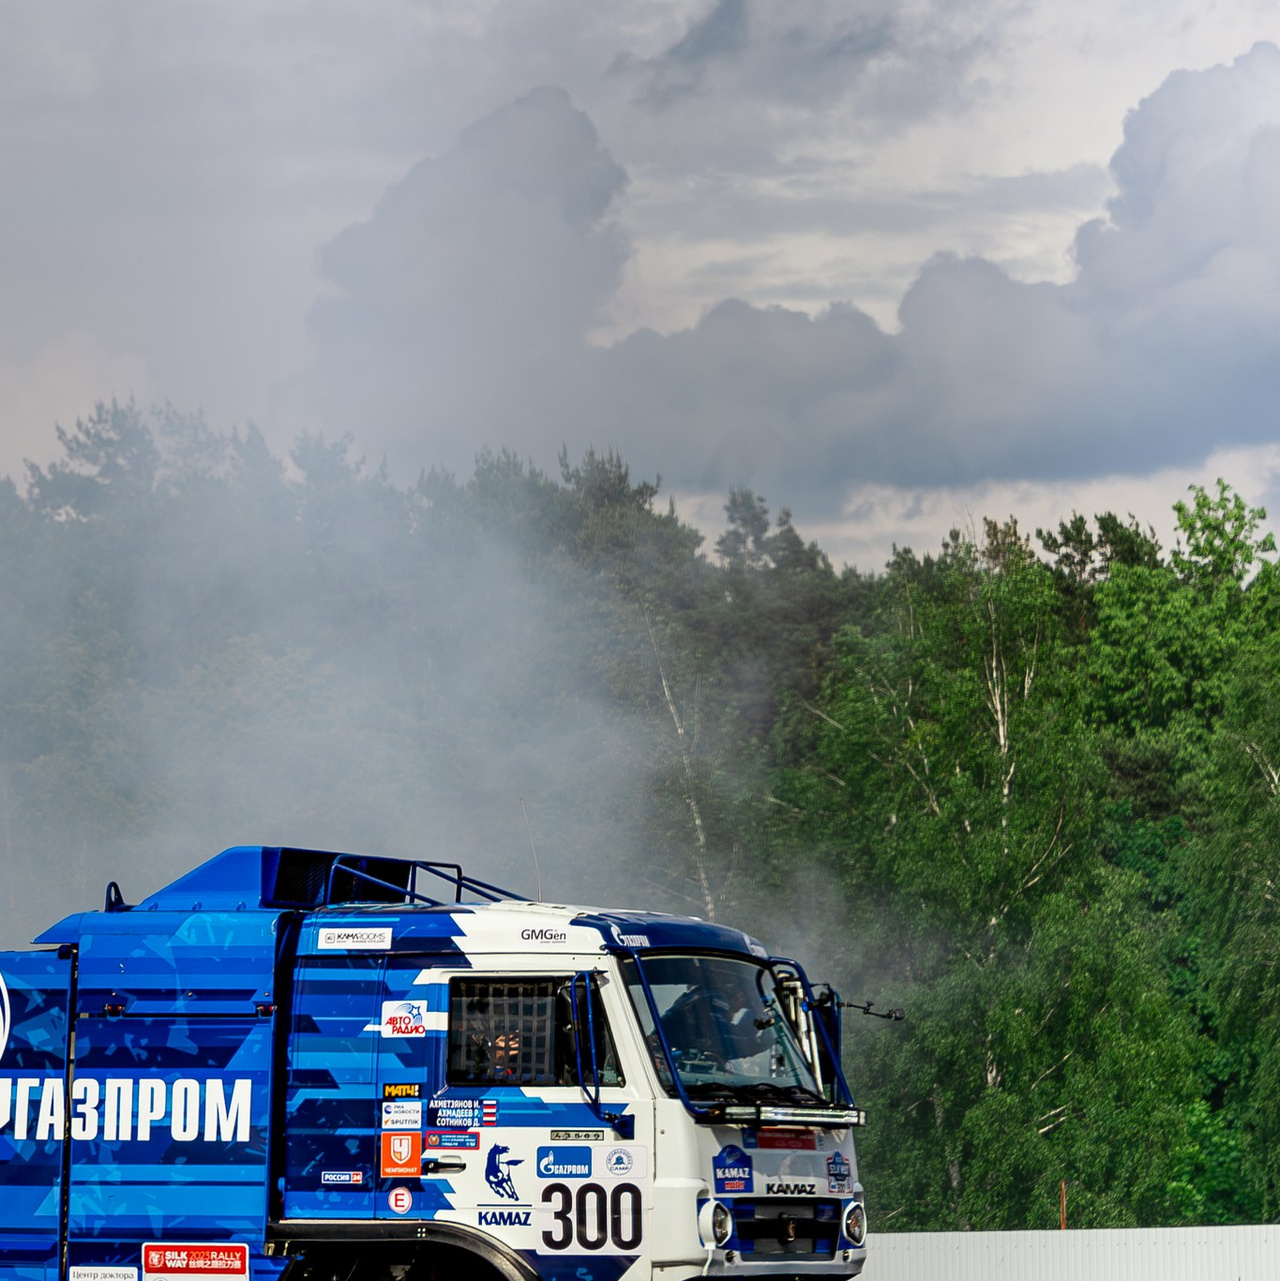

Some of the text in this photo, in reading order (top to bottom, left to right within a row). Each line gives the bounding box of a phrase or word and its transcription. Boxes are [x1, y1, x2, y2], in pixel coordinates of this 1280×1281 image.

[521, 928, 567, 941] GMGen
[392, 1025, 426, 1035] РАДИО
[429, 1099, 473, 1109] АХМЕТЗЯНОВ
[14, 1077, 252, 1142] ГАЗПРОМ
[437, 1108, 473, 1118] АХМАДЕЕВ
[436, 1117, 473, 1127] СОТНИКОВ
[554, 1164, 589, 1175] GAZPROM
[324, 1173, 350, 1182] РОССИЯ
[766, 1182, 817, 1196] KAMAZ
[394, 1192, 406, 1208] E
[478, 1211, 532, 1227] KAMAZ
[541, 1182, 643, 1251] 300
[165, 1251, 242, 1261] SILK 2023 RALLY
[165, 1259, 188, 1268] WAY
[72, 1271, 134, 1281] Центр доктора
